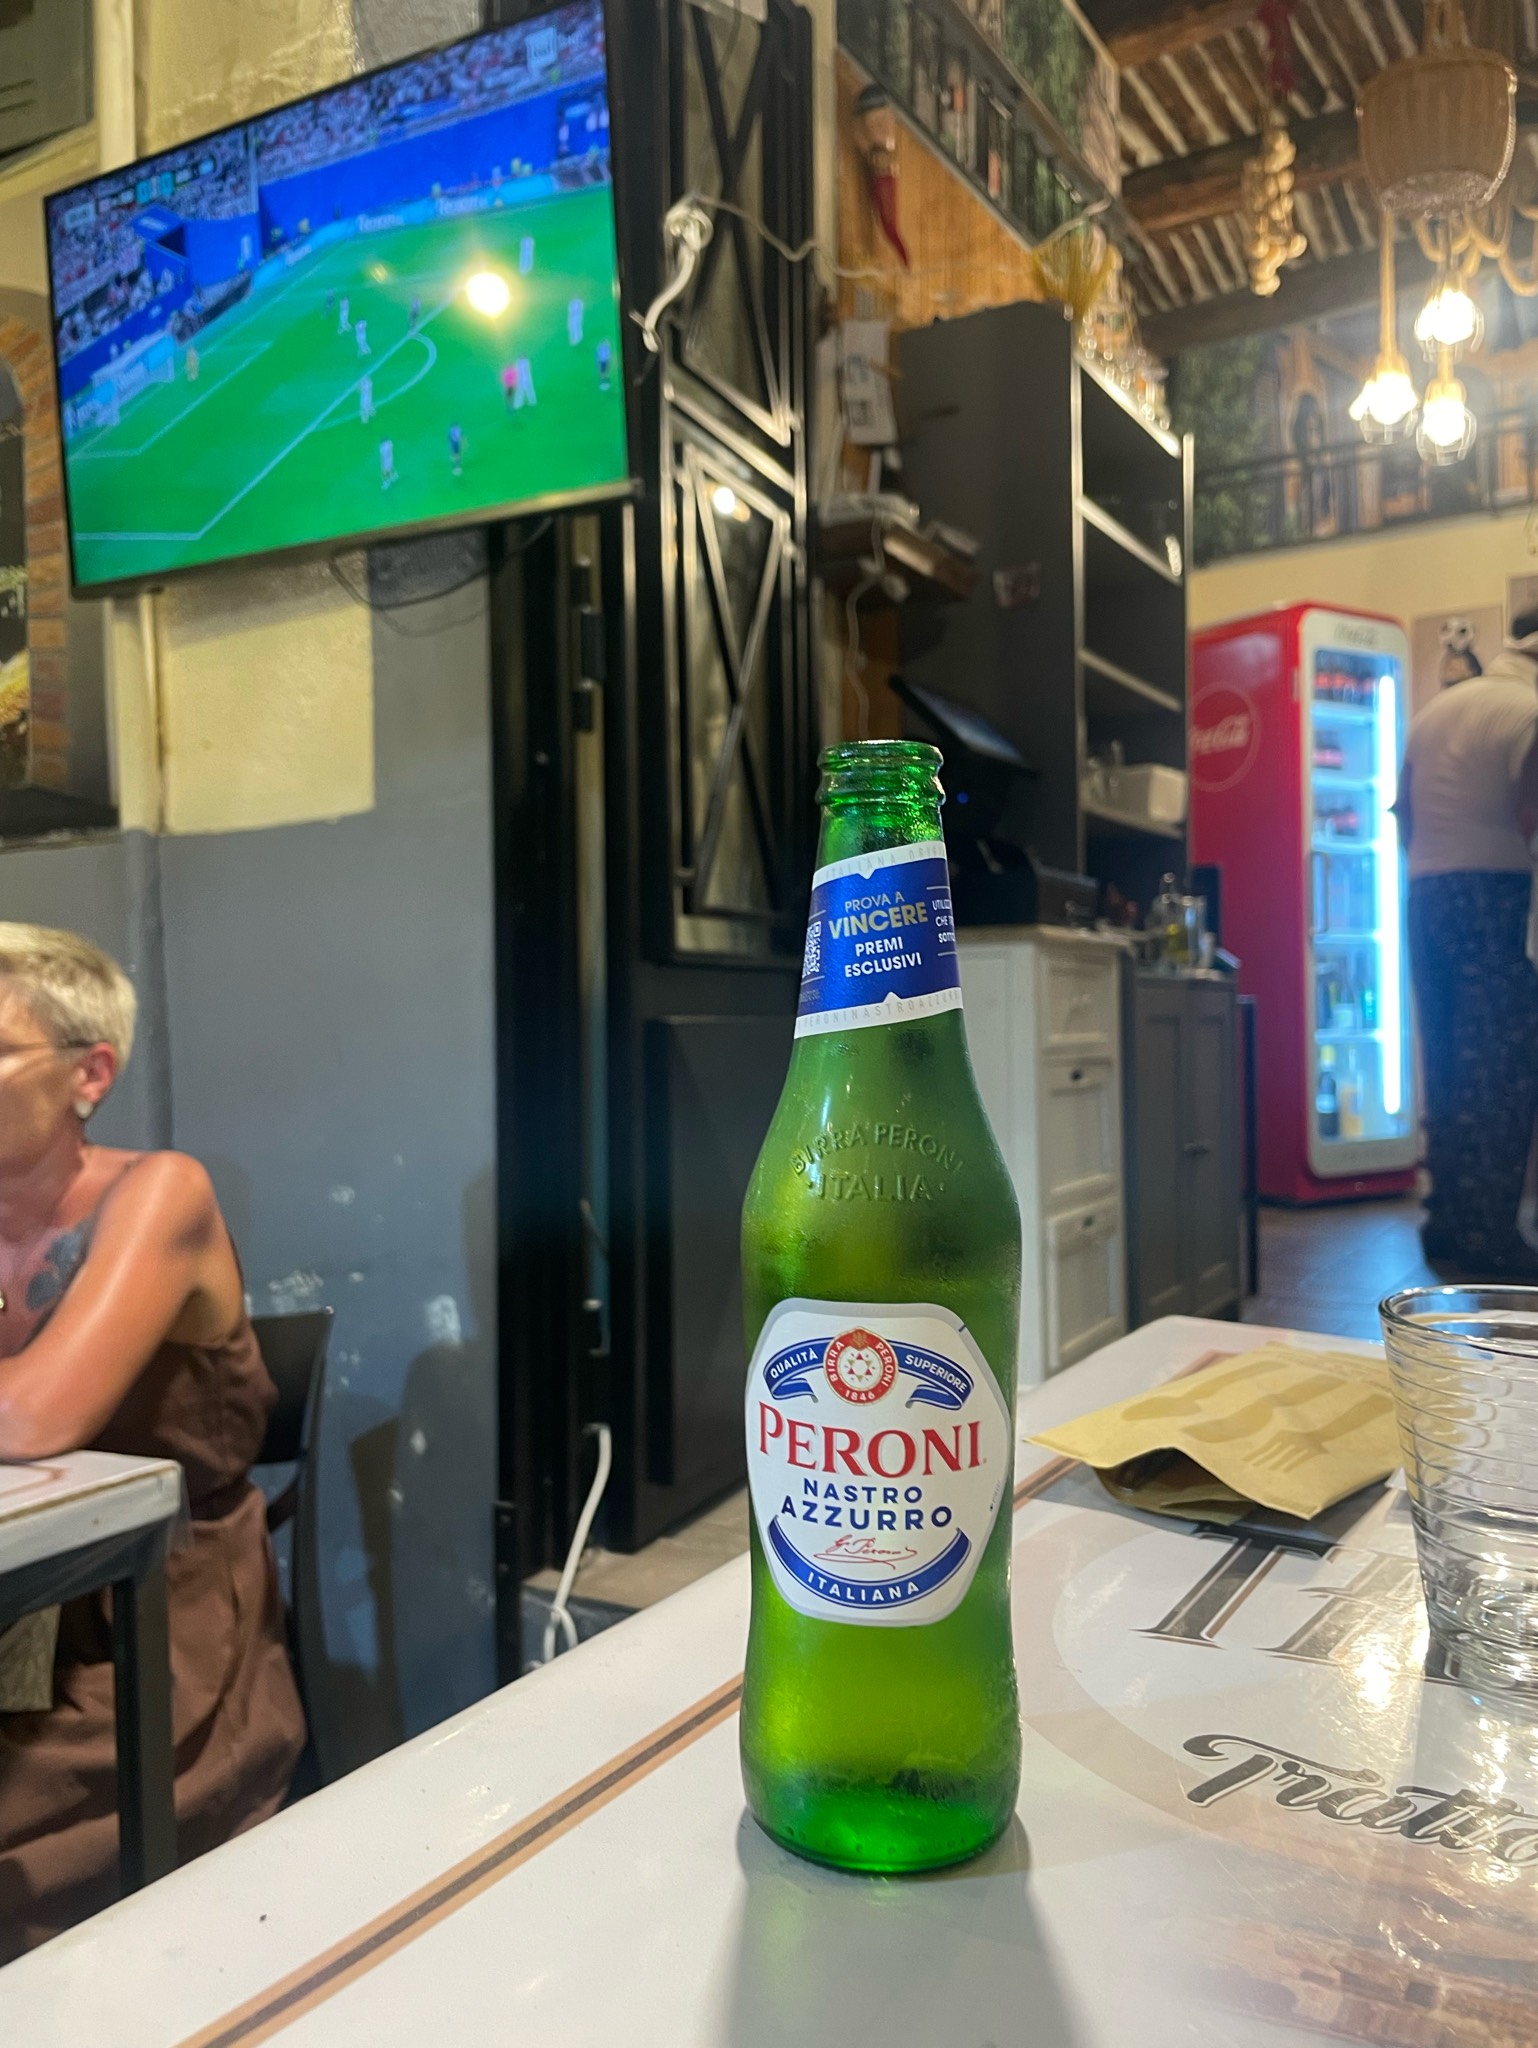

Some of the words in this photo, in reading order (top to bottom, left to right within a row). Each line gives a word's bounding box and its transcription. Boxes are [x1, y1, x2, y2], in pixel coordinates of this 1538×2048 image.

[844, 893, 891, 913] PROVA
[895, 891, 905, 903] A
[828, 901, 929, 940] VINCERE
[855, 936, 904, 957] PREMI
[844, 951, 922, 978] ESCLUSIVI
[790, 1121, 868, 1177] BIRRA
[874, 1121, 964, 1173] PERONI
[769, 1347, 819, 1380] QUALITÀ
[904, 1353, 968, 1393] SUPERIORE
[827, 1341, 845, 1382] BIRRA
[875, 1341, 894, 1387] PERONI
[844, 1389, 876, 1401] 1846
[758, 1400, 981, 1479] PERONI
[803, 1477, 923, 1504] NASTRO
[781, 1495, 953, 1531] AZZURRO
[808, 1571, 920, 1602] ITALIANA
